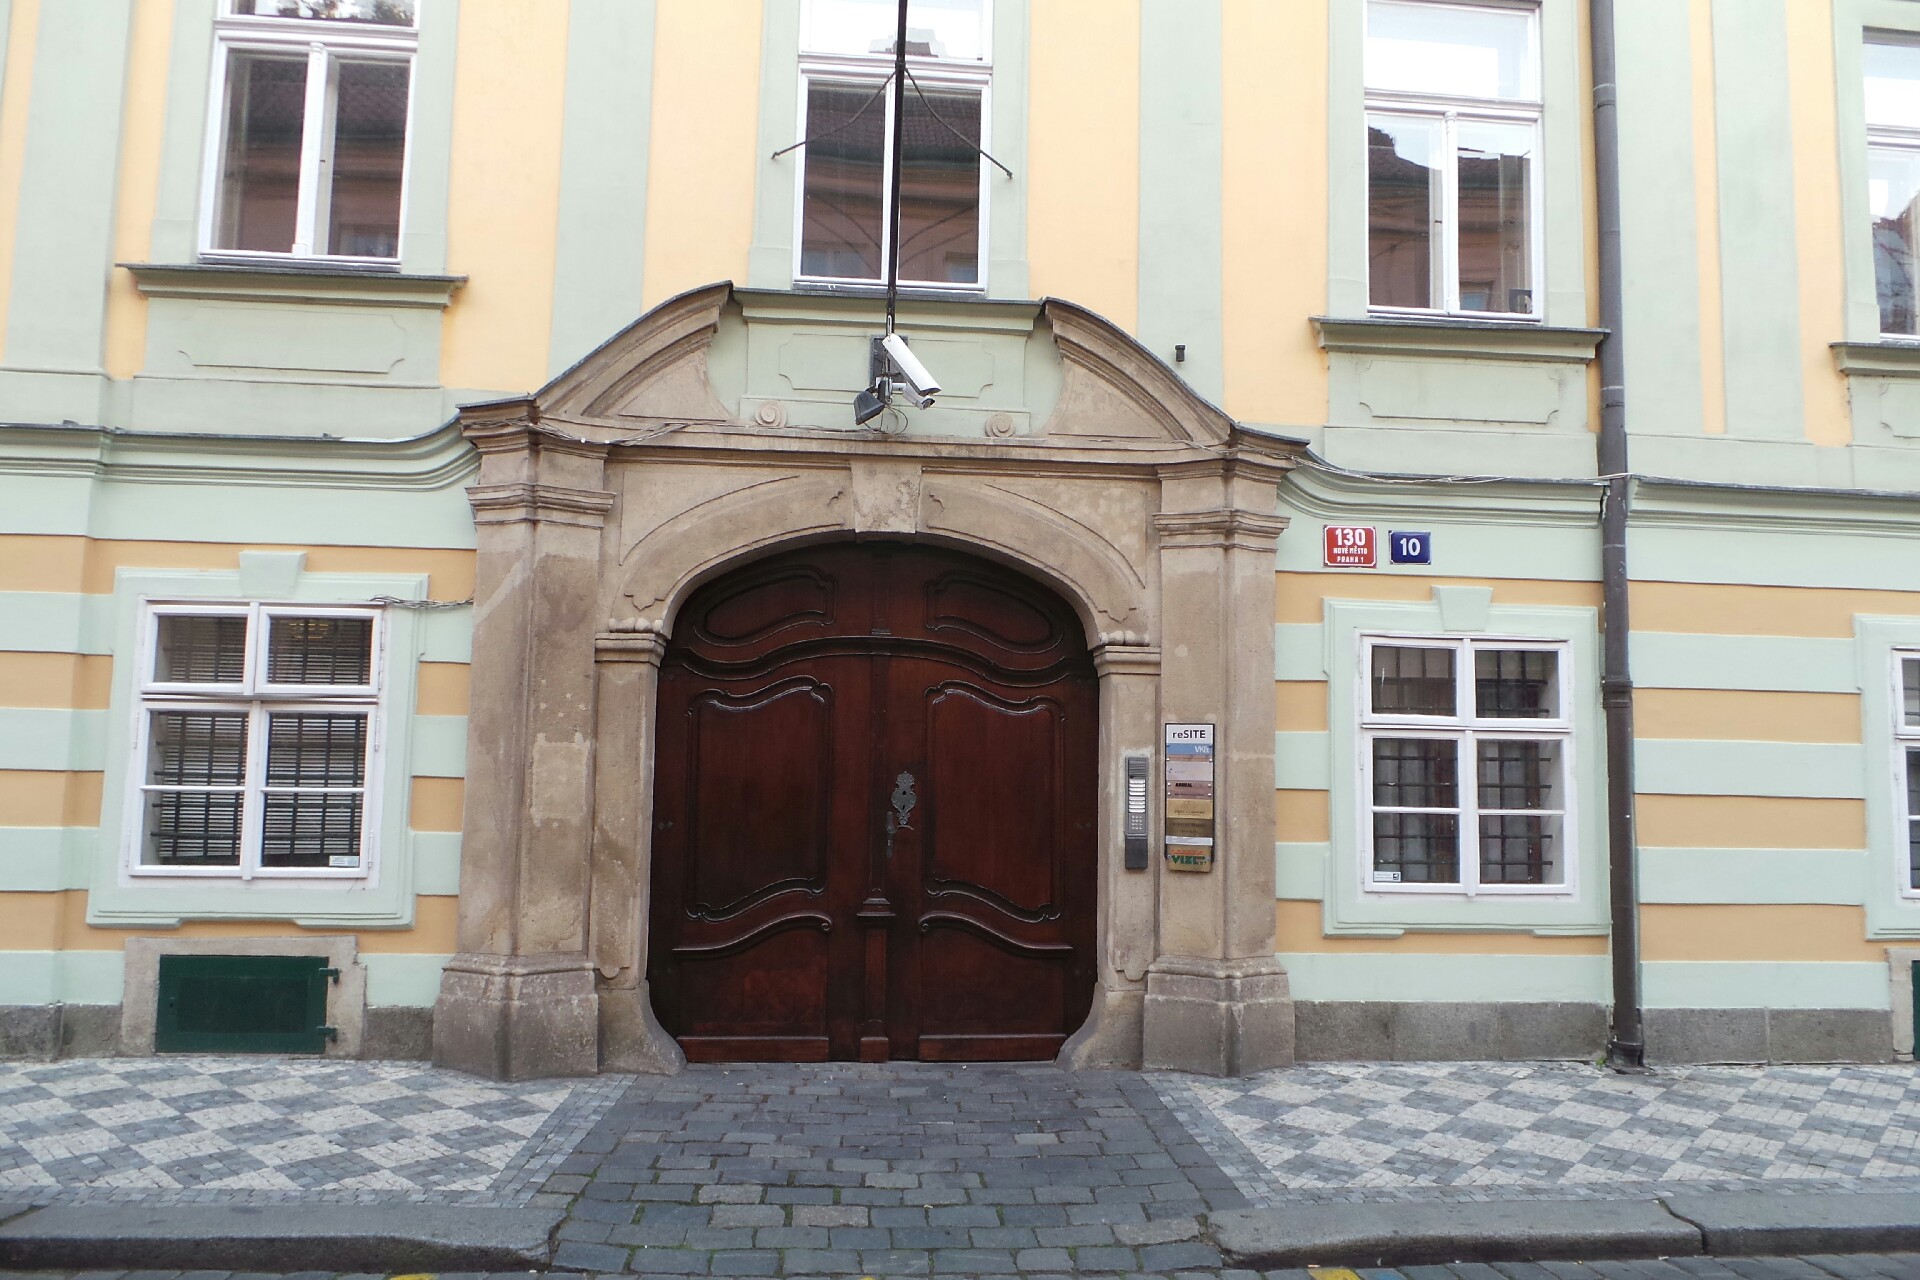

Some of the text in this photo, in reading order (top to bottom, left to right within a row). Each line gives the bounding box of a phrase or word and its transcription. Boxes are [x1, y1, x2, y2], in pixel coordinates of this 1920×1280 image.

[1335, 528, 1366, 546] 130
[1333, 545, 1368, 555] NOVÉ MĚSTO
[1399, 537, 1421, 556] 10
[1337, 555, 1359, 563] PRAHA
[1172, 729, 1206, 739] reSITE
